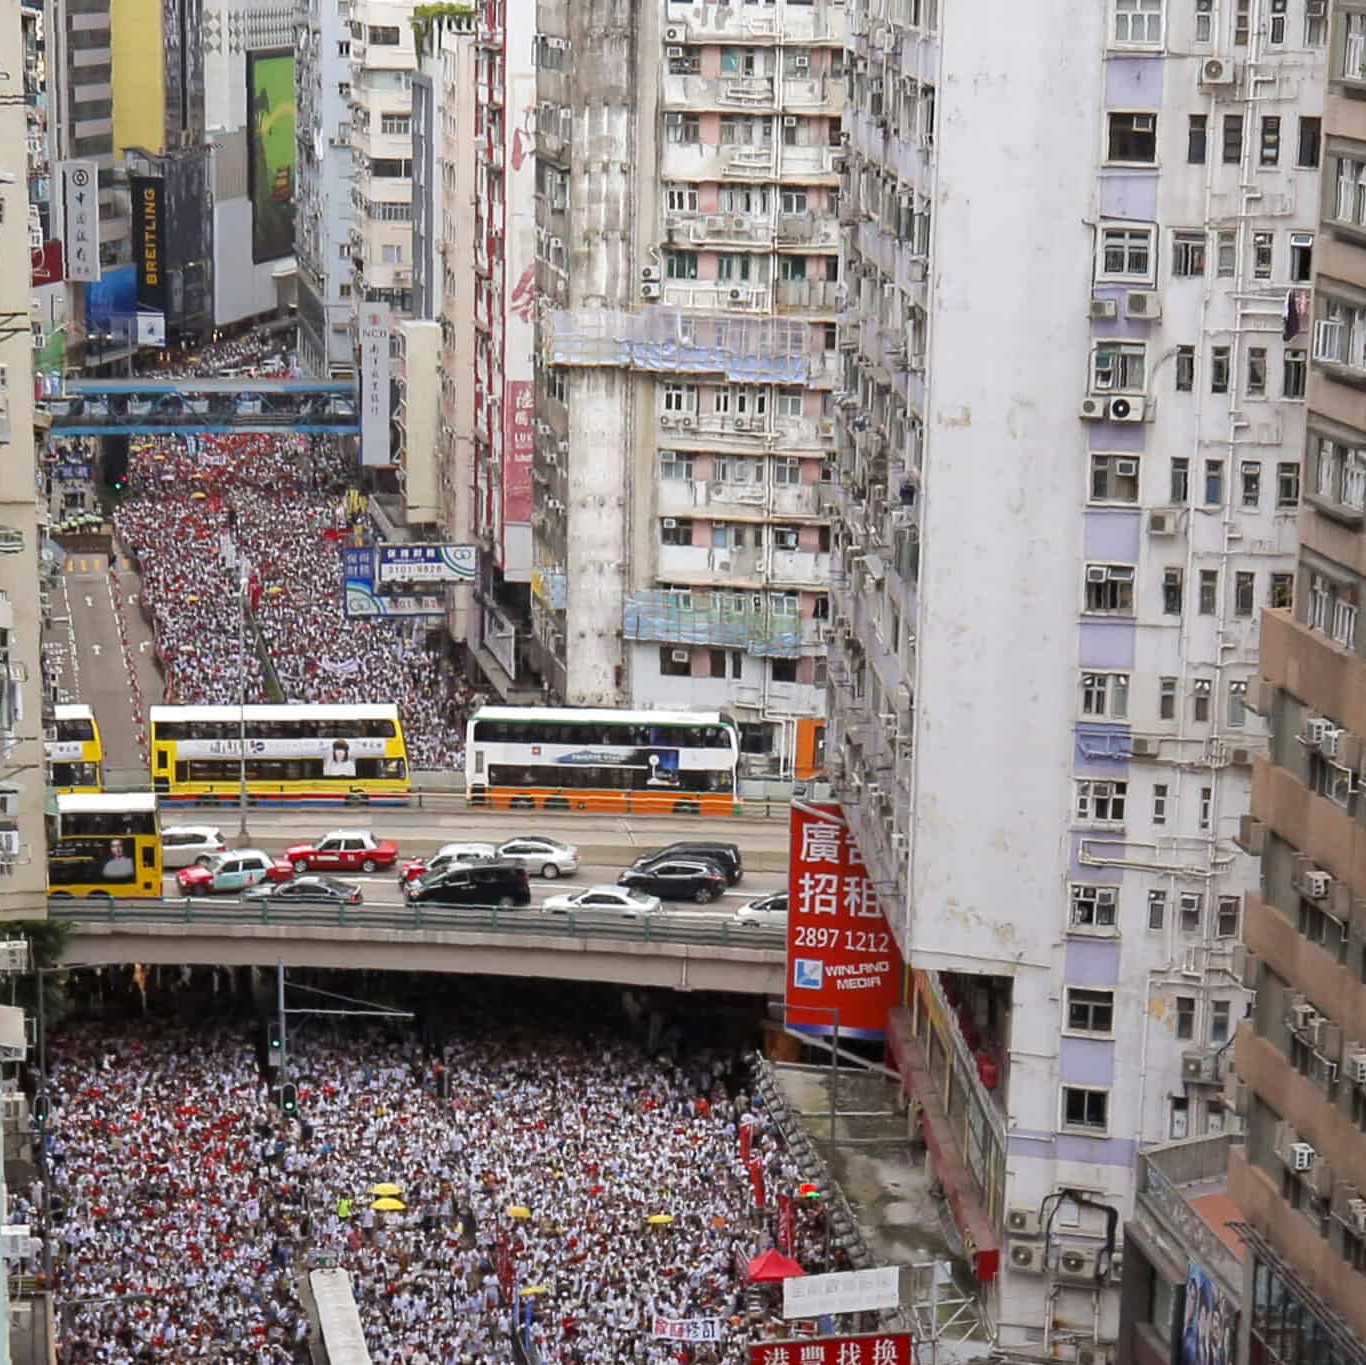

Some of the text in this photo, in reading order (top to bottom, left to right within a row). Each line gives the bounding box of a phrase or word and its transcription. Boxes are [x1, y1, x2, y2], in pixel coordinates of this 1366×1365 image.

[144, 188, 158, 285] BREITLING
[798, 872, 884, 918] 招租
[795, 926, 889, 952] 2897 1212
[825, 961, 890, 976] WINLAND
[836, 977, 882, 990] MEDIA
